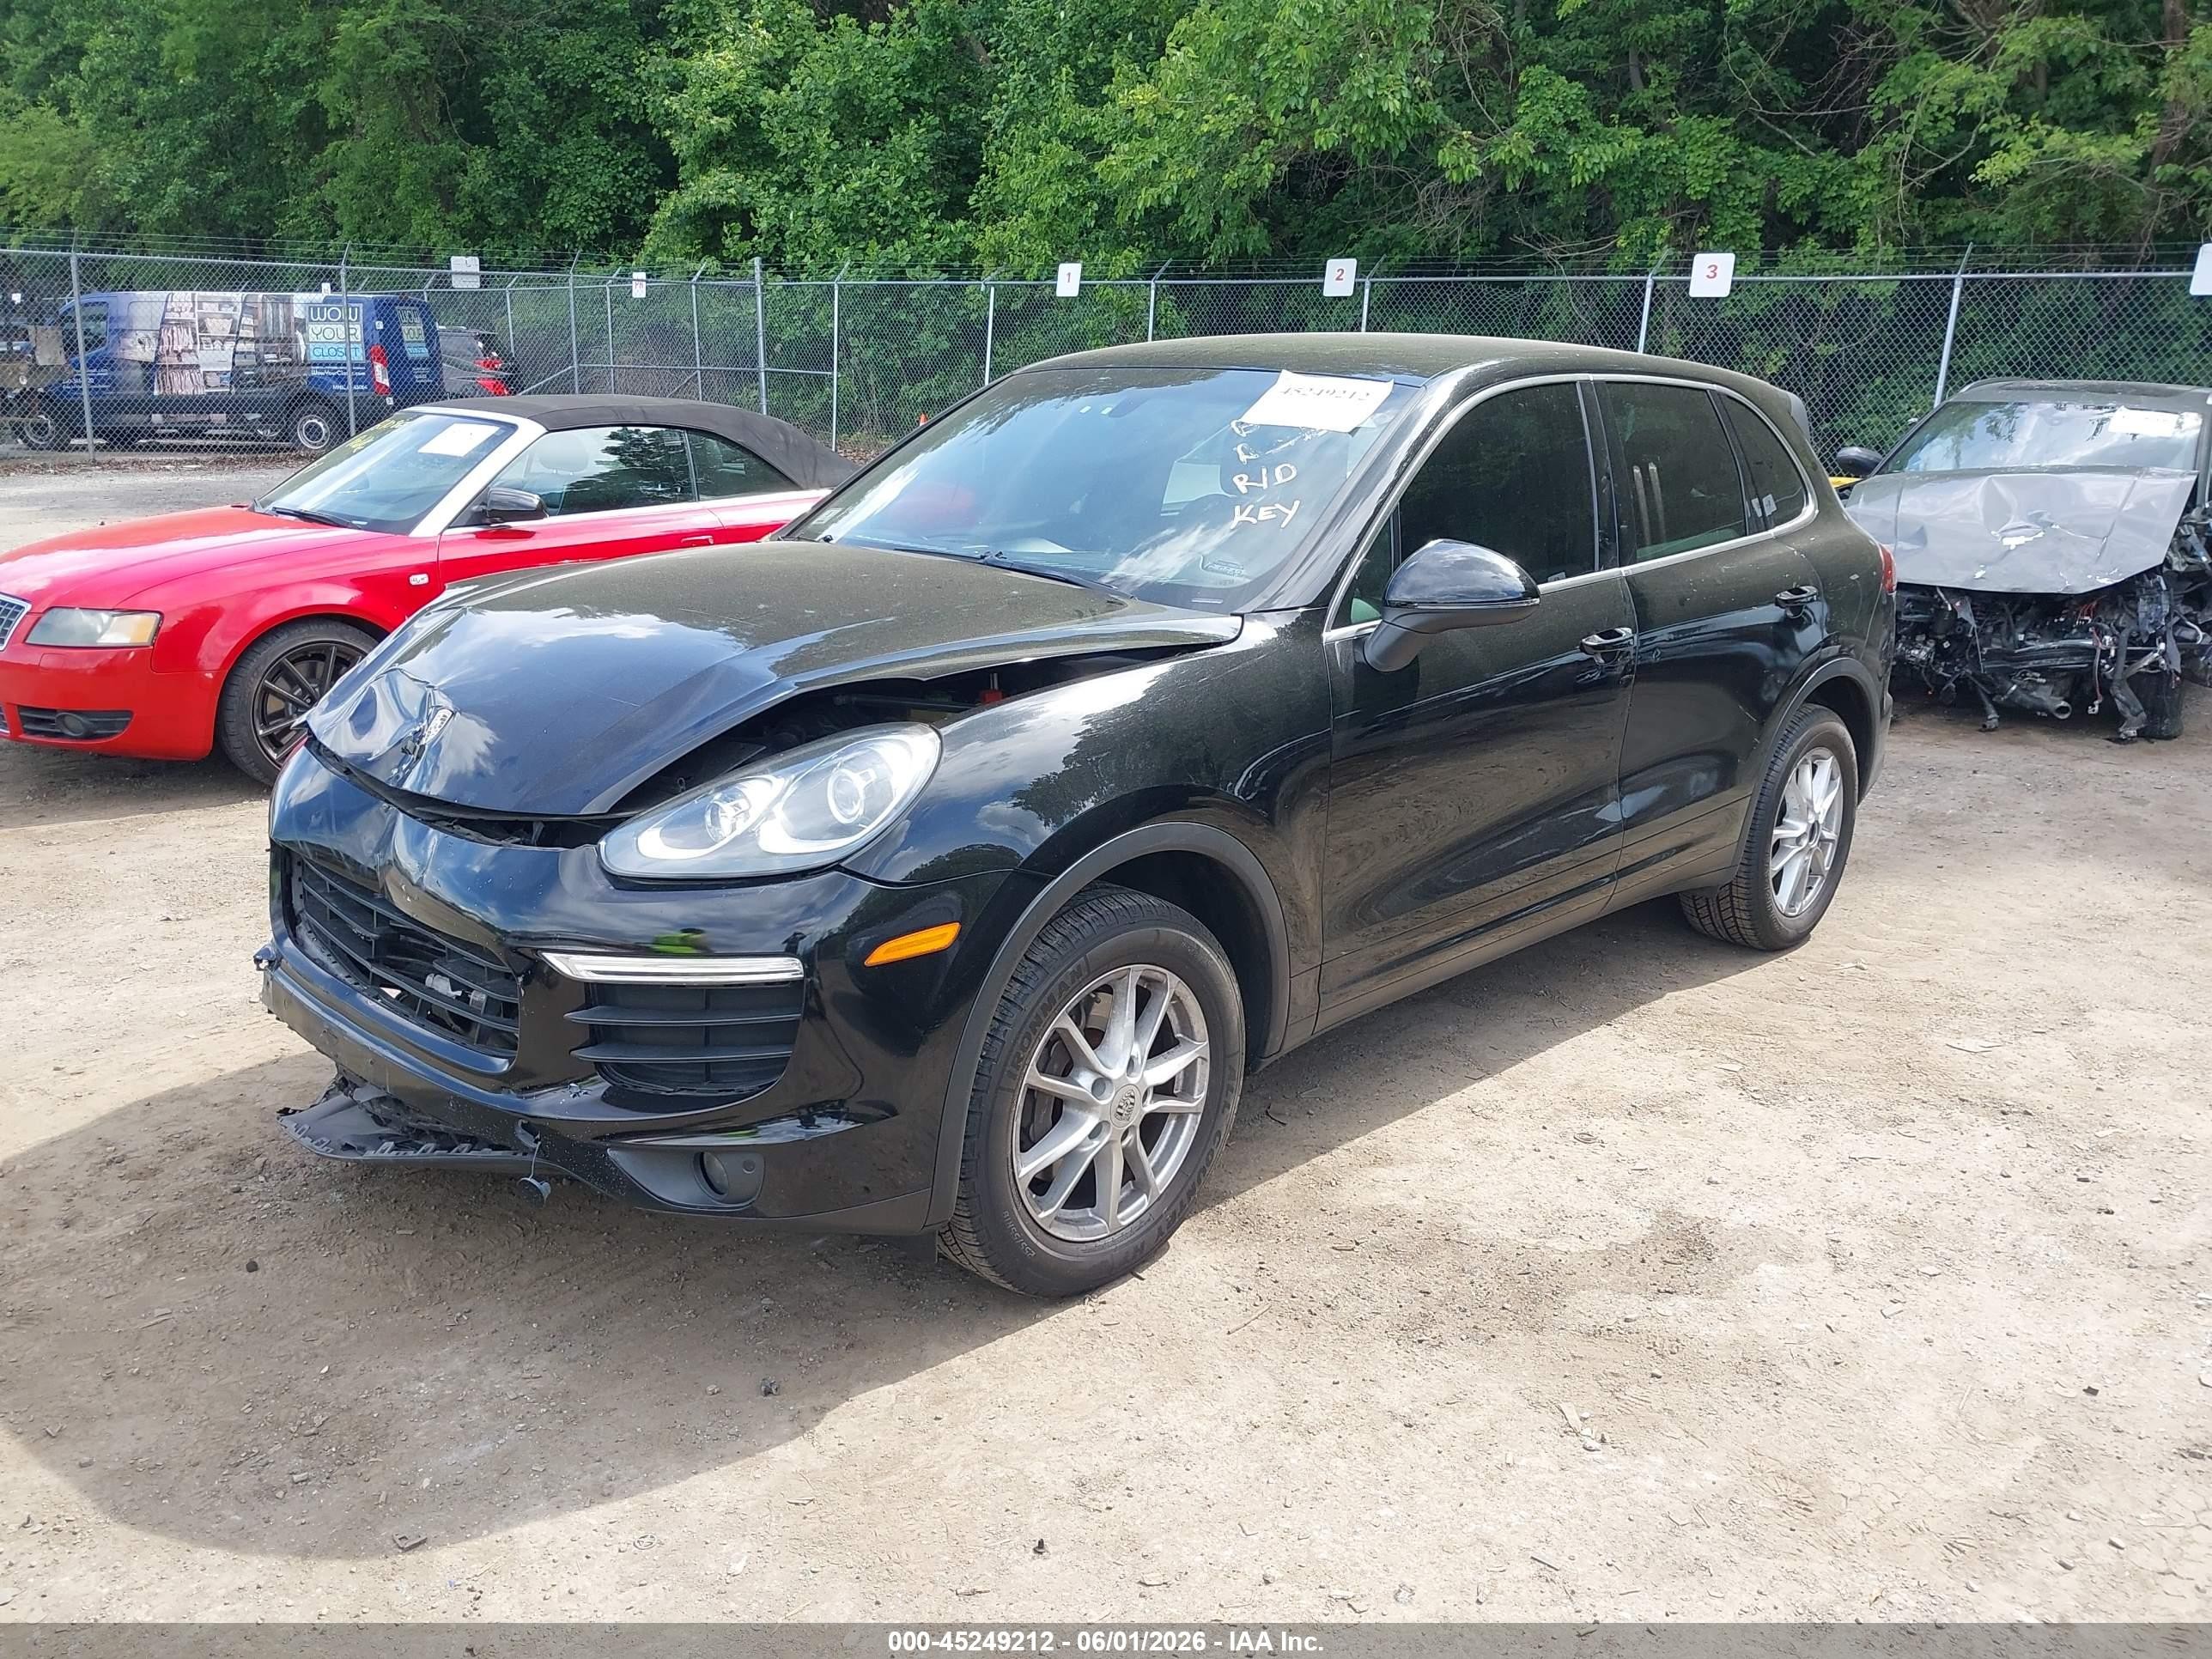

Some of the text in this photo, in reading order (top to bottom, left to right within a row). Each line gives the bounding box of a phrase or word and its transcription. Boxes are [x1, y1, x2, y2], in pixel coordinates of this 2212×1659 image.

[1066, 271, 1072, 283] 1
[1335, 268, 1345, 282] 2
[1705, 264, 1718, 279] 3
[310, 307, 358, 322] WOW
[311, 326, 360, 341] YOUR
[313, 346, 360, 357] CLOST
[1230, 500, 1301, 530] KEY
[1006, 961, 1085, 1080] IRONMAN
[1154, 1129, 1223, 1245] COUNTRY
